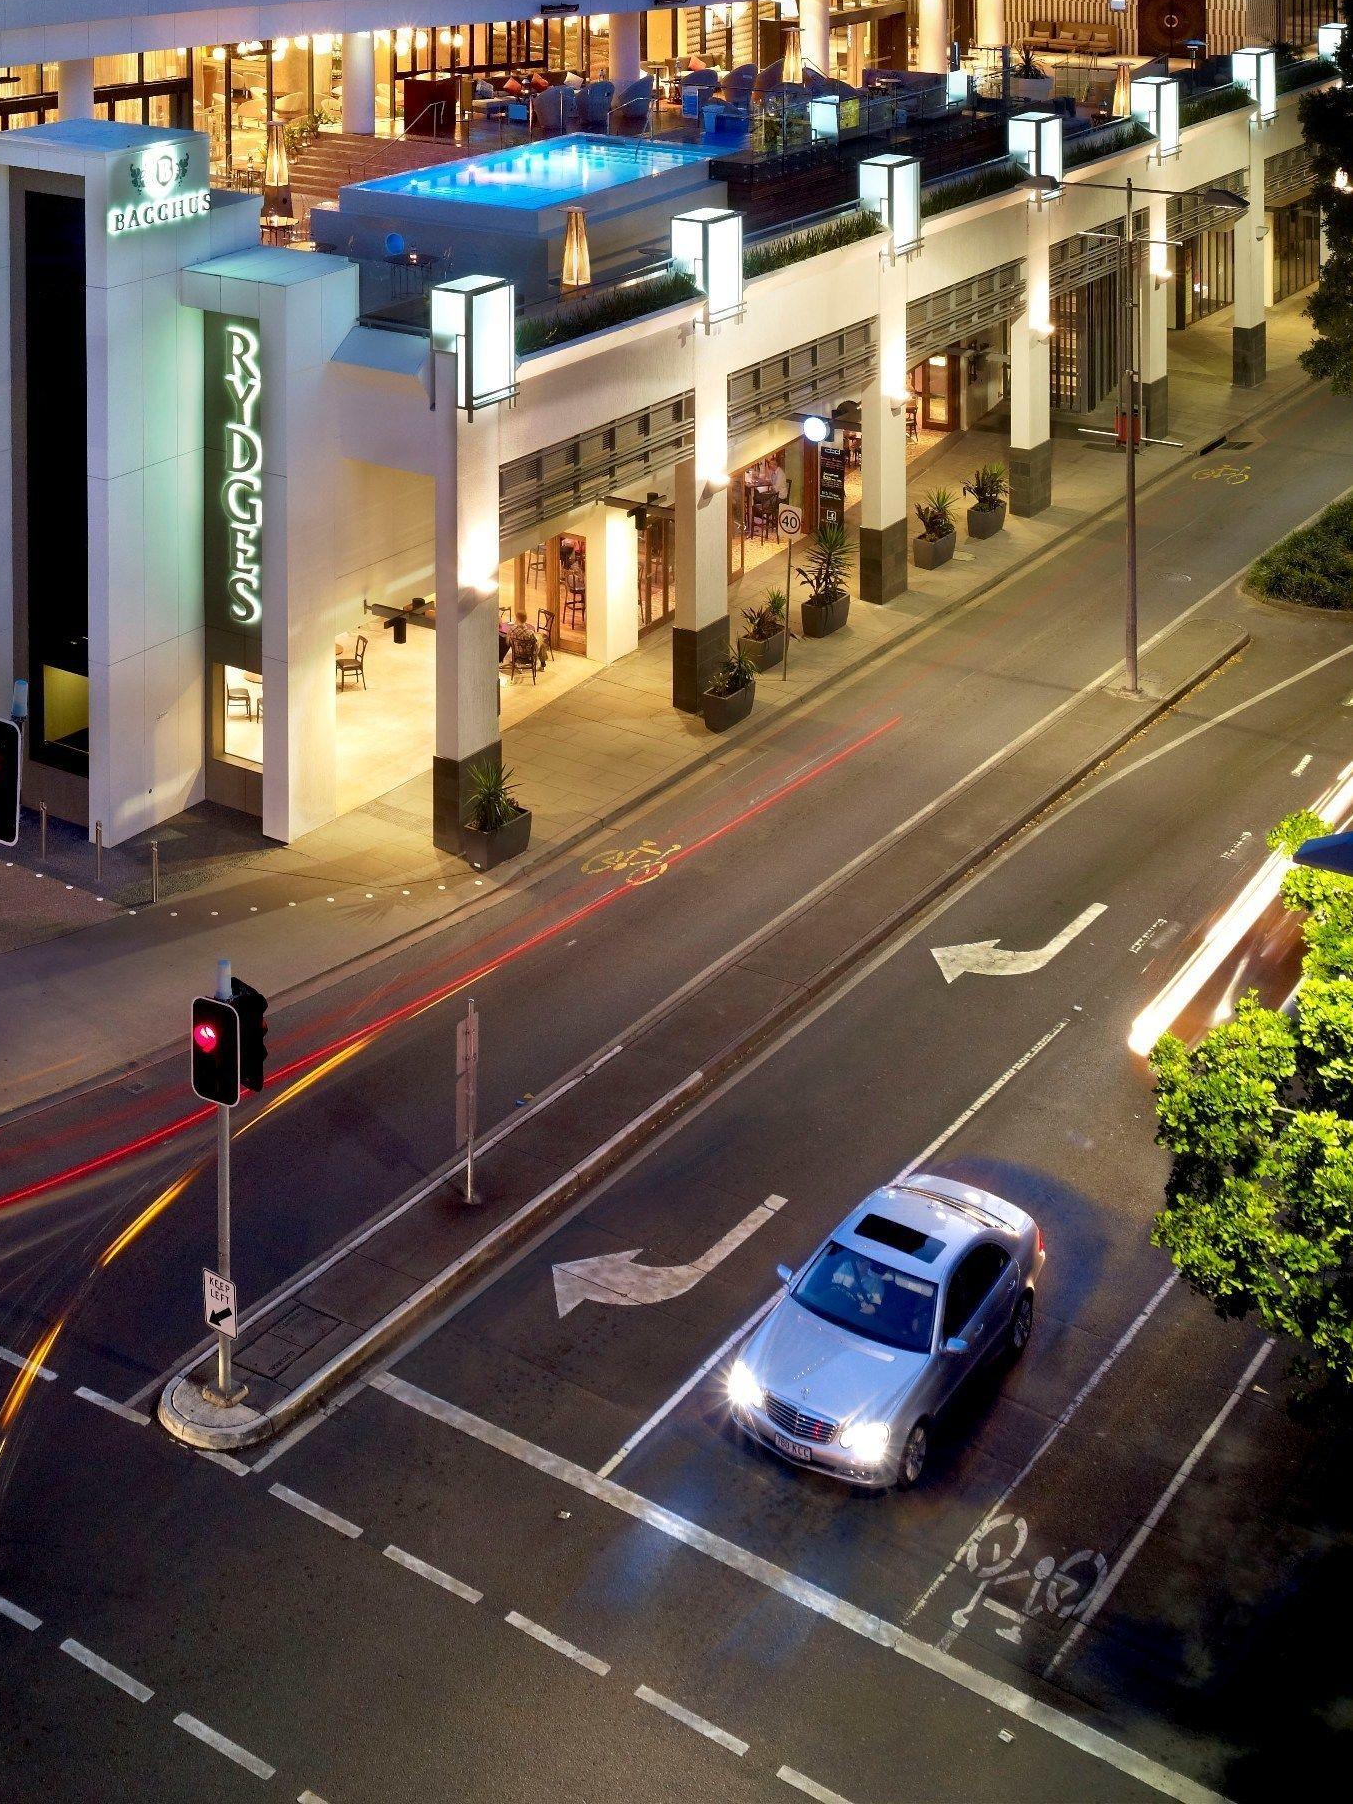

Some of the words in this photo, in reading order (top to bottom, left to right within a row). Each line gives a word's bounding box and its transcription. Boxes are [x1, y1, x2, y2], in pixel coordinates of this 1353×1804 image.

[113, 193, 212, 232] BACCHUS
[221, 326, 260, 623] RYDGES
[781, 515, 798, 529] 40
[209, 1276, 230, 1293] KEEP
[210, 1288, 229, 1305] LEFT
